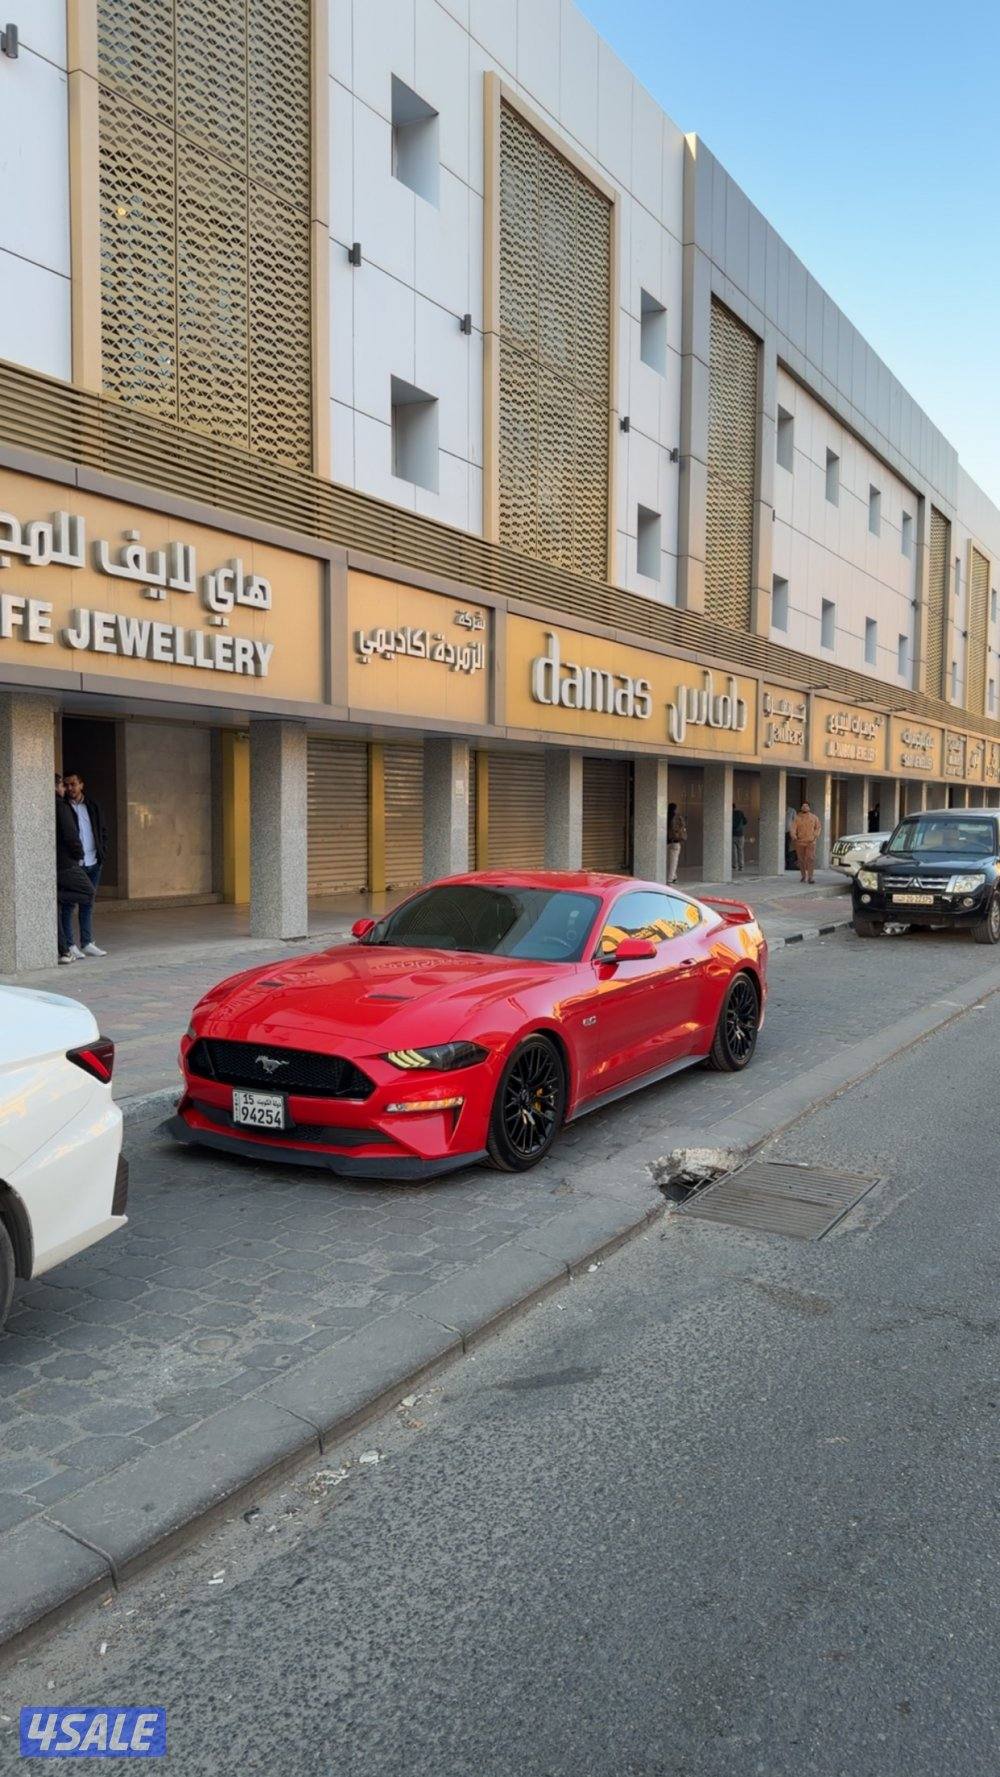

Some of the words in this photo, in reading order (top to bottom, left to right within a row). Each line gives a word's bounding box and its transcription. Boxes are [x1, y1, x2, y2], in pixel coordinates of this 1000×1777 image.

[95, 528, 196, 600] لايف
[203, 558, 272, 627] هاي
[62, 608, 274, 677] JEWELLERY
[532, 631, 652, 719] damas
[667, 669, 747, 743] داماس
[241, 1106, 281, 1126] 94254
[242, 1093, 255, 1105] 15
